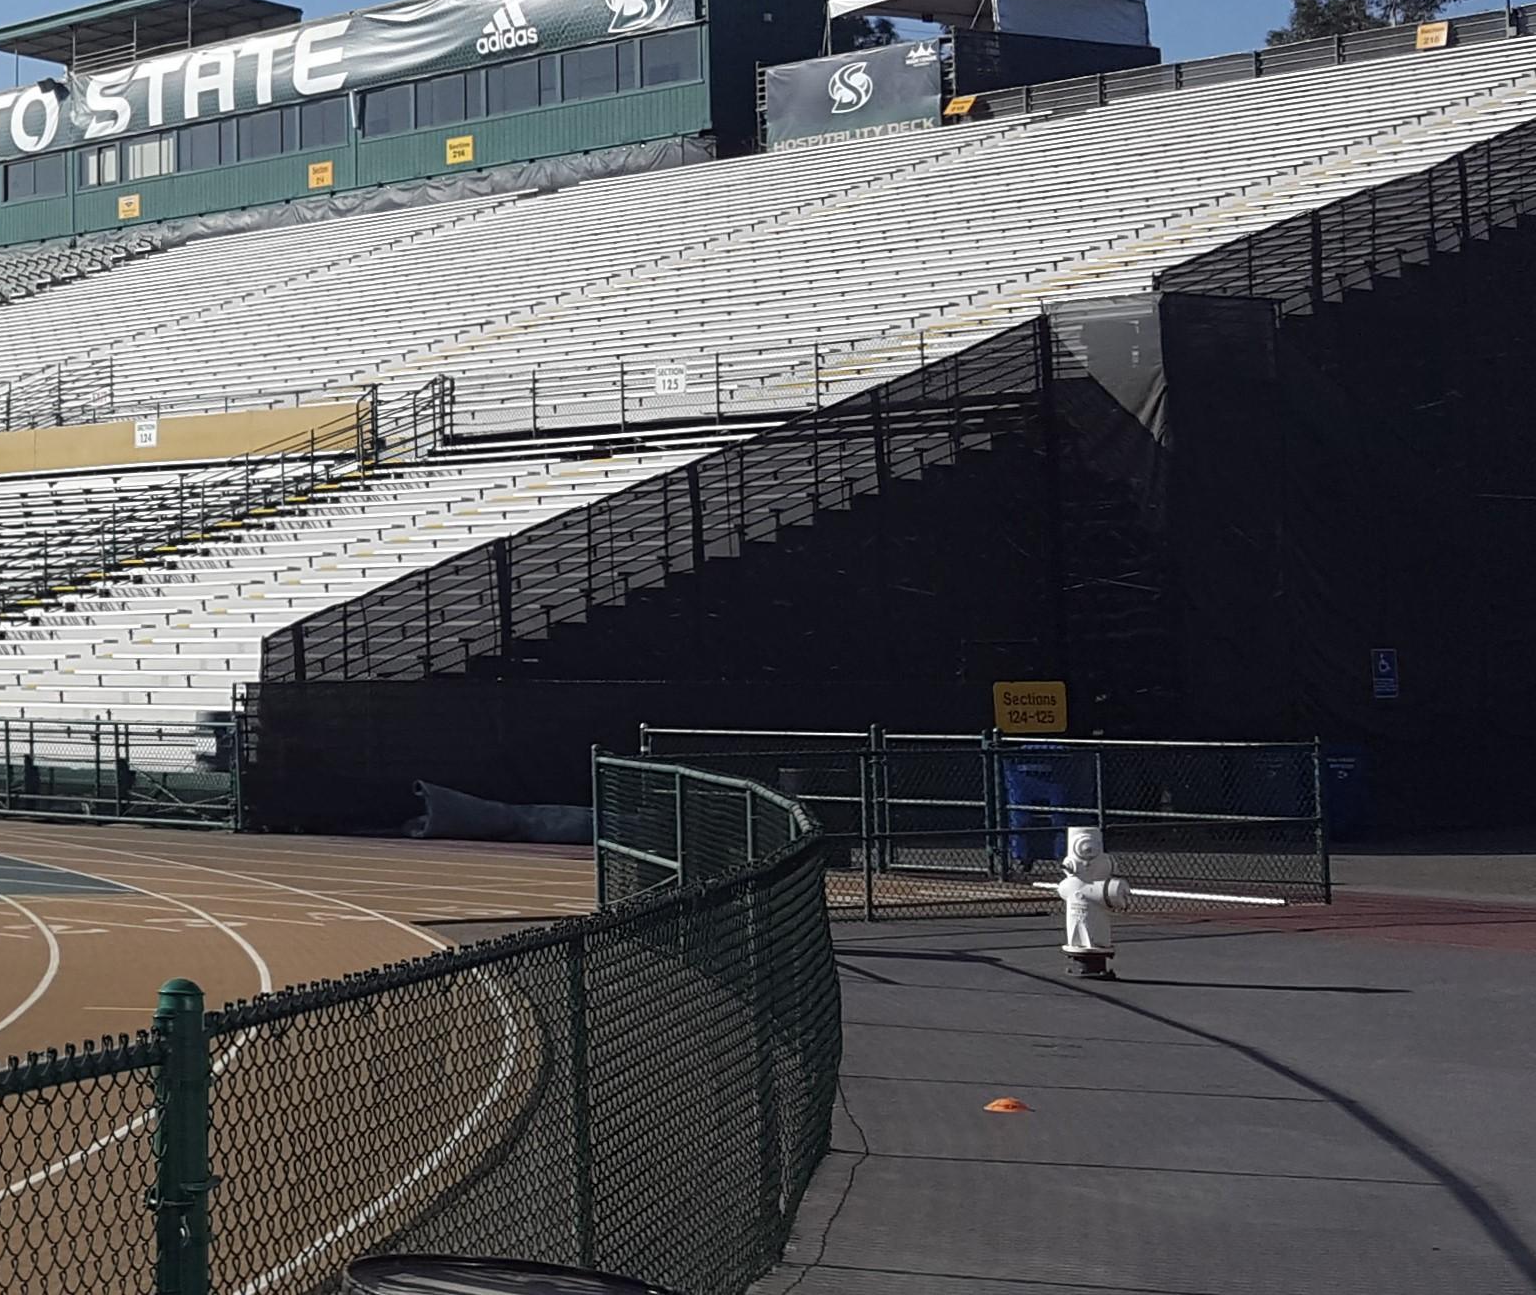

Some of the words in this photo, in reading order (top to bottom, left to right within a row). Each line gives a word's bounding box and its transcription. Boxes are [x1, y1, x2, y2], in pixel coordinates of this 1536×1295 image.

[476, 27, 538, 54] adidas
[83, 19, 351, 139] STATE
[773, 124, 886, 152] HOSPITALITY
[887, 117, 935, 135] DECK
[657, 367, 684, 376] SECTION
[662, 378, 679, 390] 125
[140, 433, 153, 443] 124
[1003, 691, 1057, 706] Sections
[1008, 710, 1056, 724] 124-125
